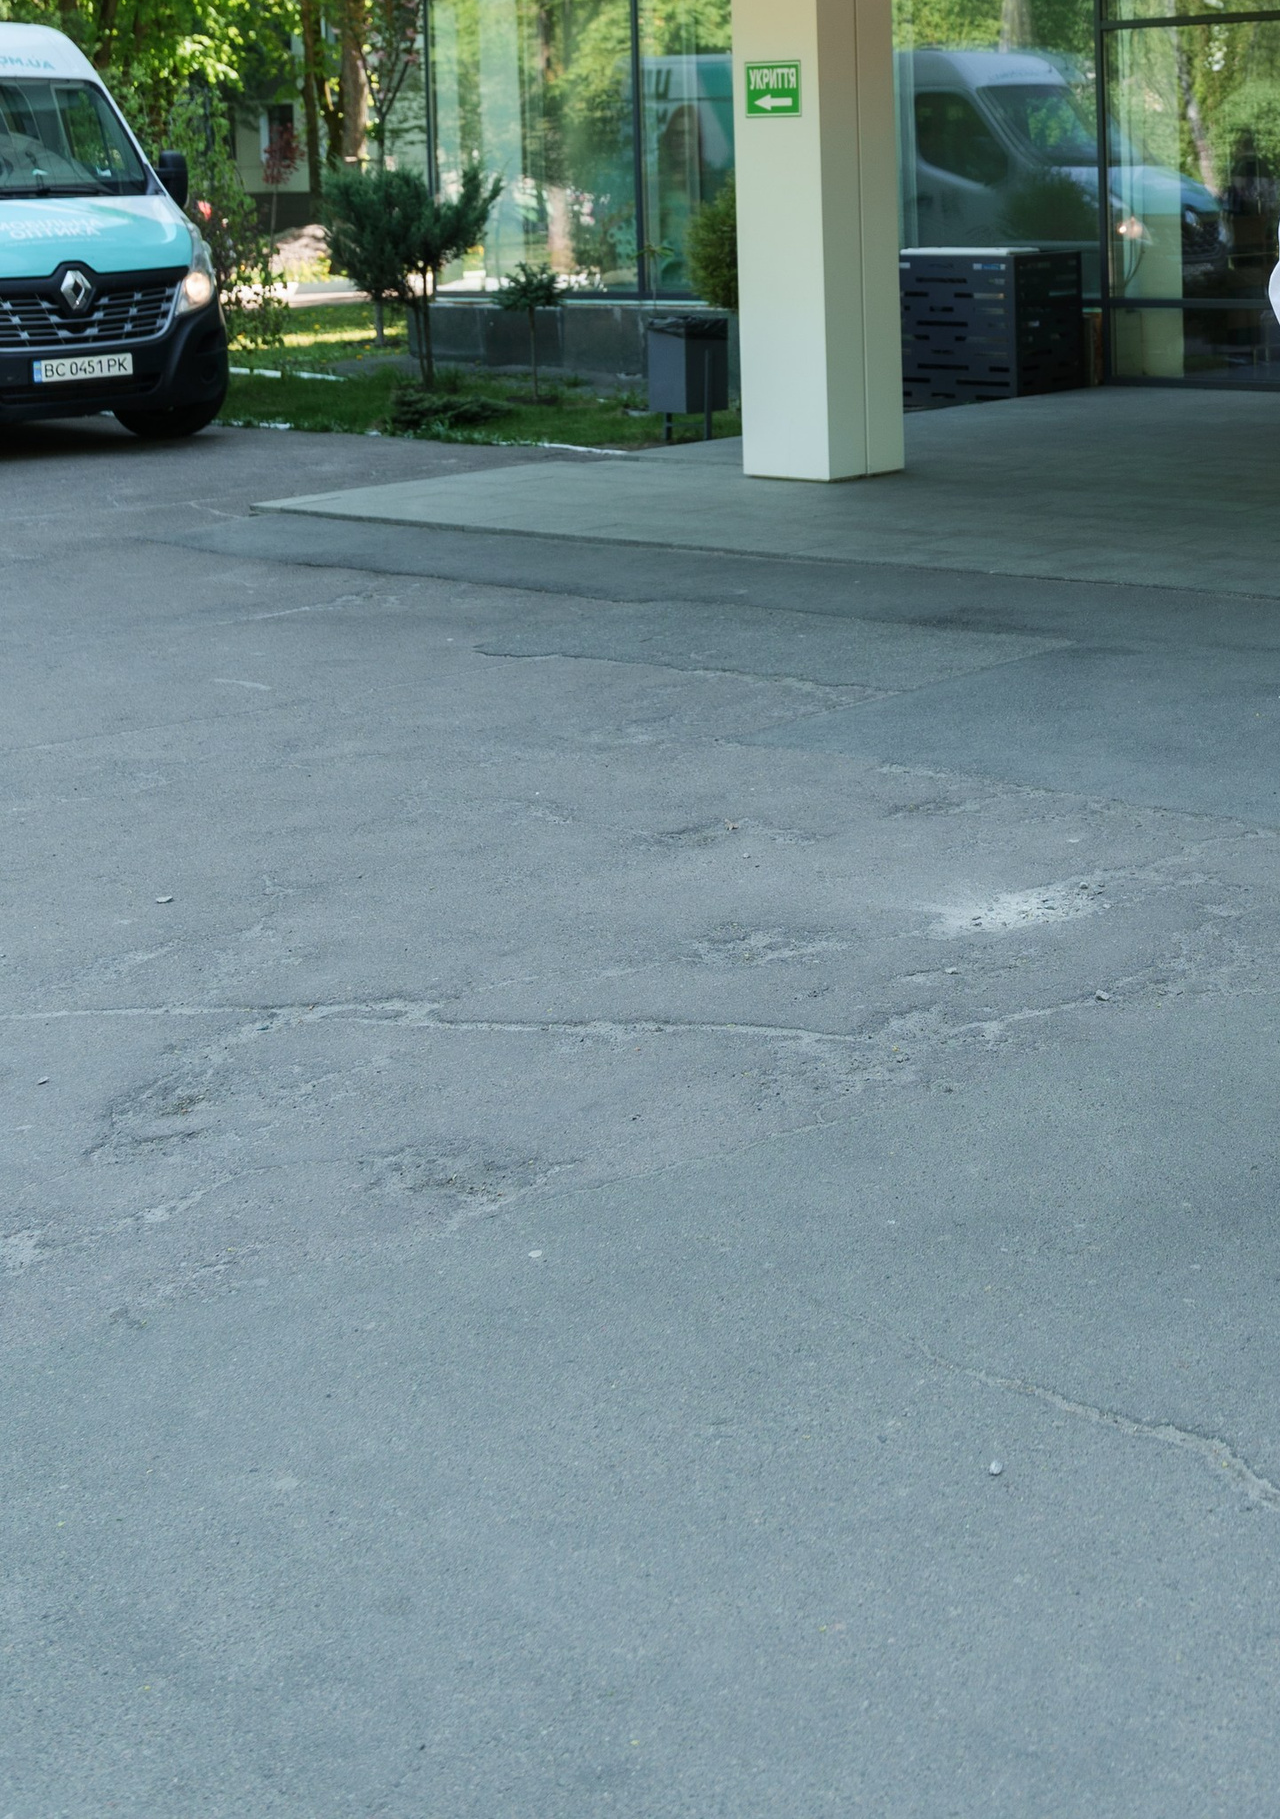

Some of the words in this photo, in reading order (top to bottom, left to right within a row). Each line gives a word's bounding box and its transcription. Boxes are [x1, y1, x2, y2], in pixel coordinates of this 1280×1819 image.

[748, 67, 797, 91] УКРИТТЯ
[44, 363, 66, 378] BC
[69, 359, 104, 376] 0451
[106, 356, 128, 372] PK
